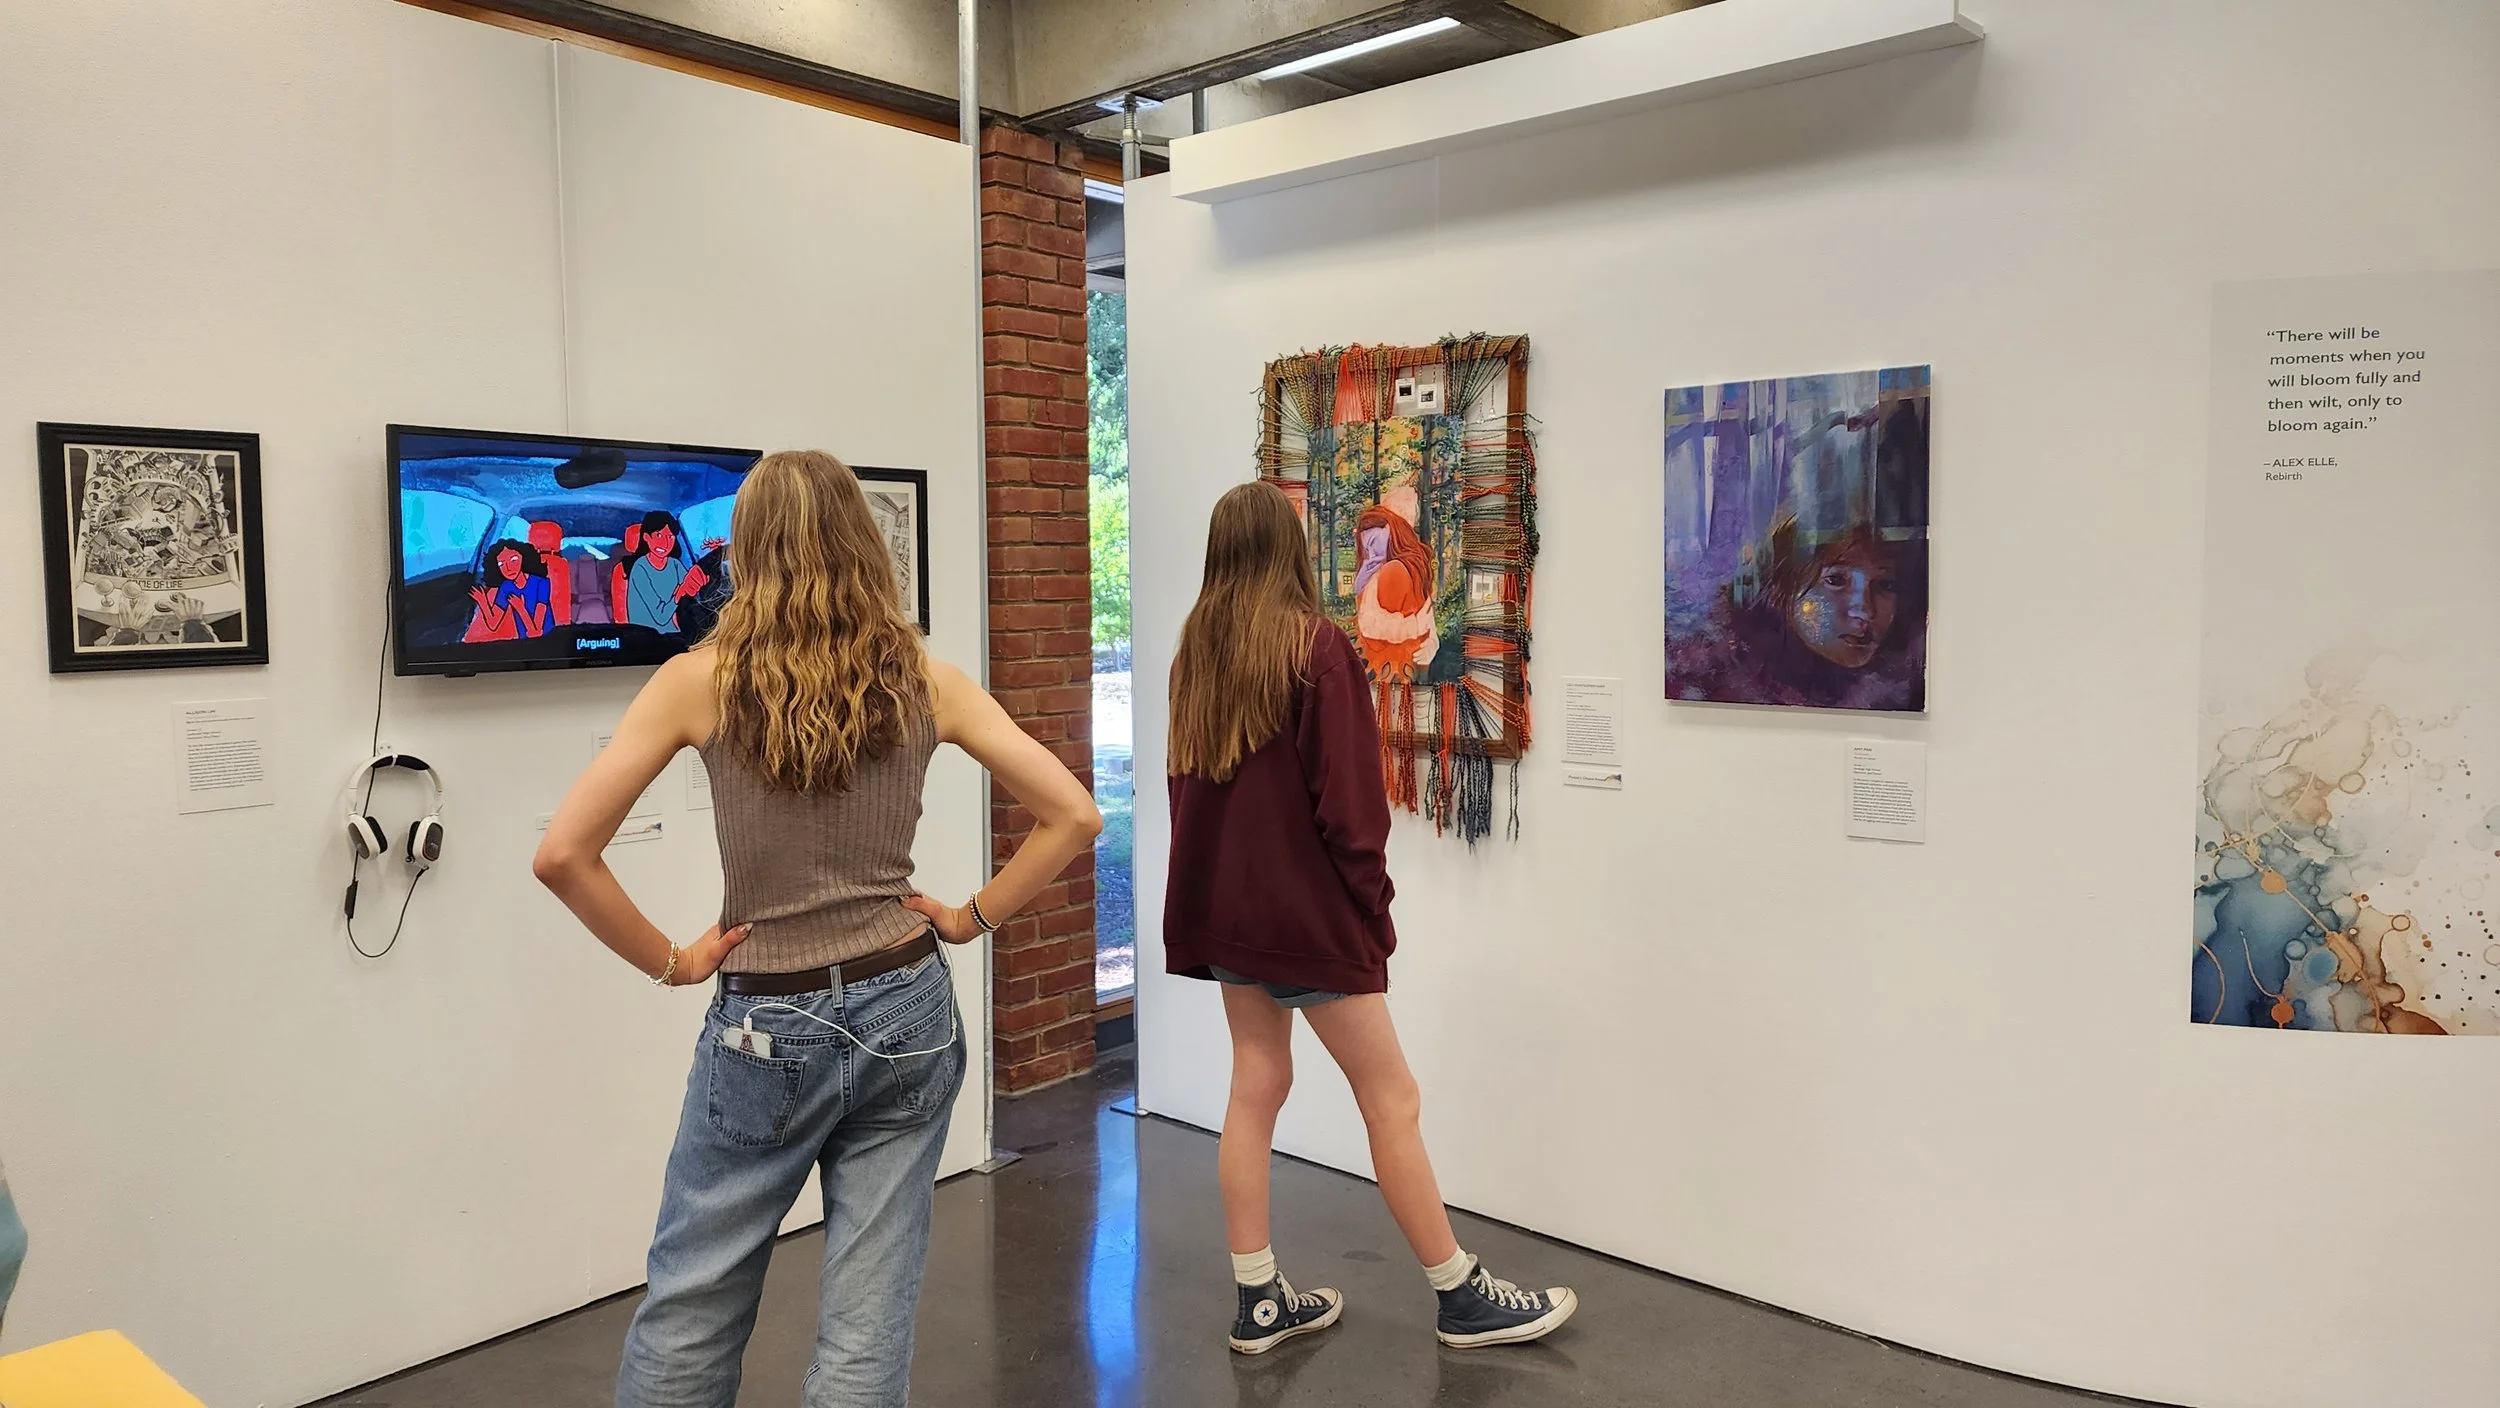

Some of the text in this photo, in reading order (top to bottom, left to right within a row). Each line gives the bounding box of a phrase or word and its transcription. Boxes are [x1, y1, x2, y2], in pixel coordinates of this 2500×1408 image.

[2328, 327, 2356, 341] will
[2361, 327, 2381, 339] be
[2270, 350, 2426, 366] moments when you
[2267, 370, 2422, 388] will bloom fully and
[2267, 394, 2403, 410] then wilt, only to
[2267, 419, 2319, 432] bloom
[2308, 456, 2338, 468] ELLE,
[2265, 471, 2303, 482] Rebirth
[153, 580, 165, 589] OF
[166, 579, 183, 588] LIFE
[576, 637, 620, 650] [Arguing]
